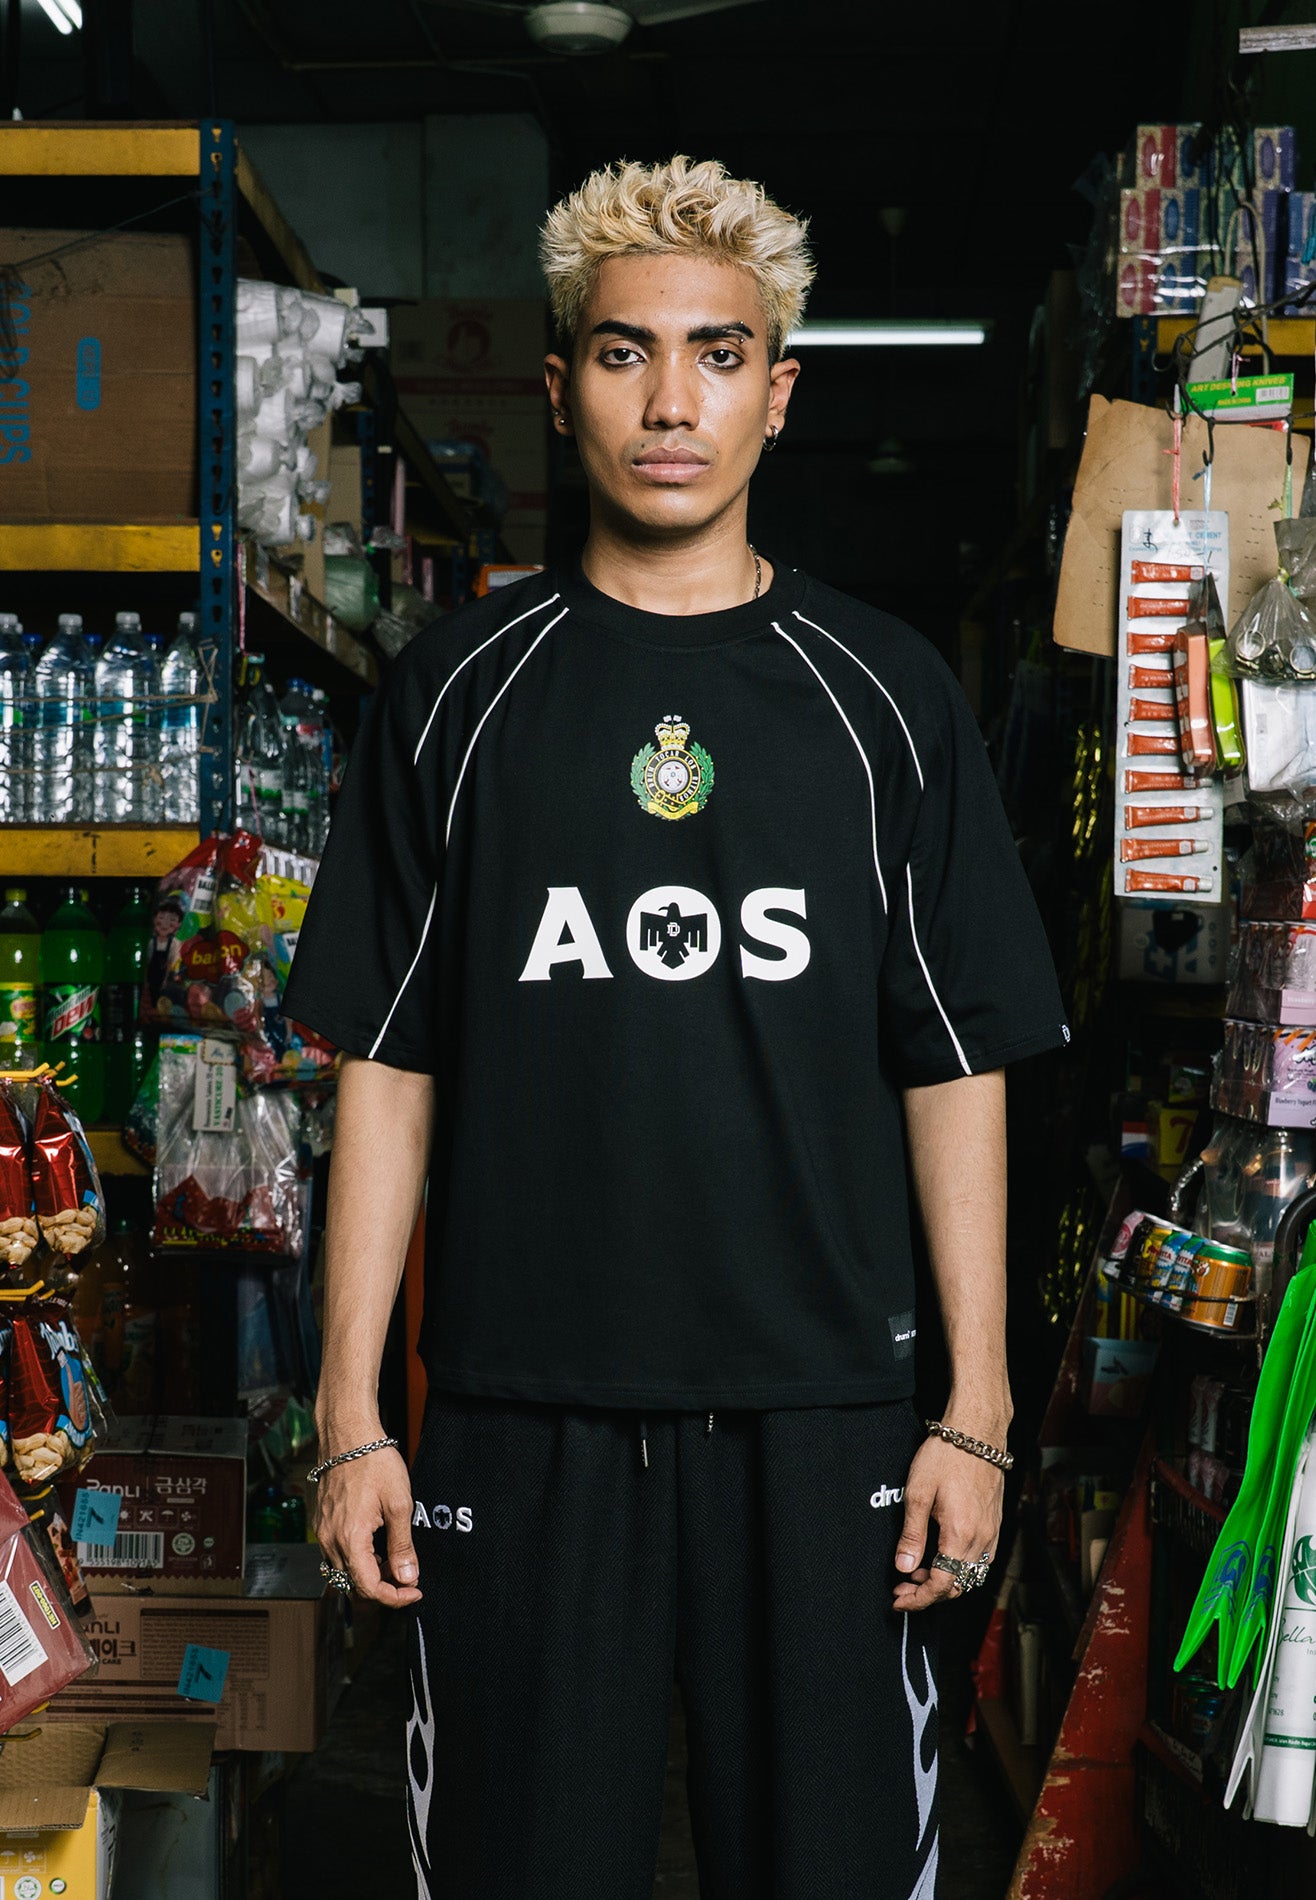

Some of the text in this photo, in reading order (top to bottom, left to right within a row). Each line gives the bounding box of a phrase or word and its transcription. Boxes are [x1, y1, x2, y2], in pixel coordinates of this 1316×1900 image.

[518, 885, 811, 982] AOS
[154, 1476, 208, 1496] 금삼각
[412, 1500, 473, 1533] AOS
